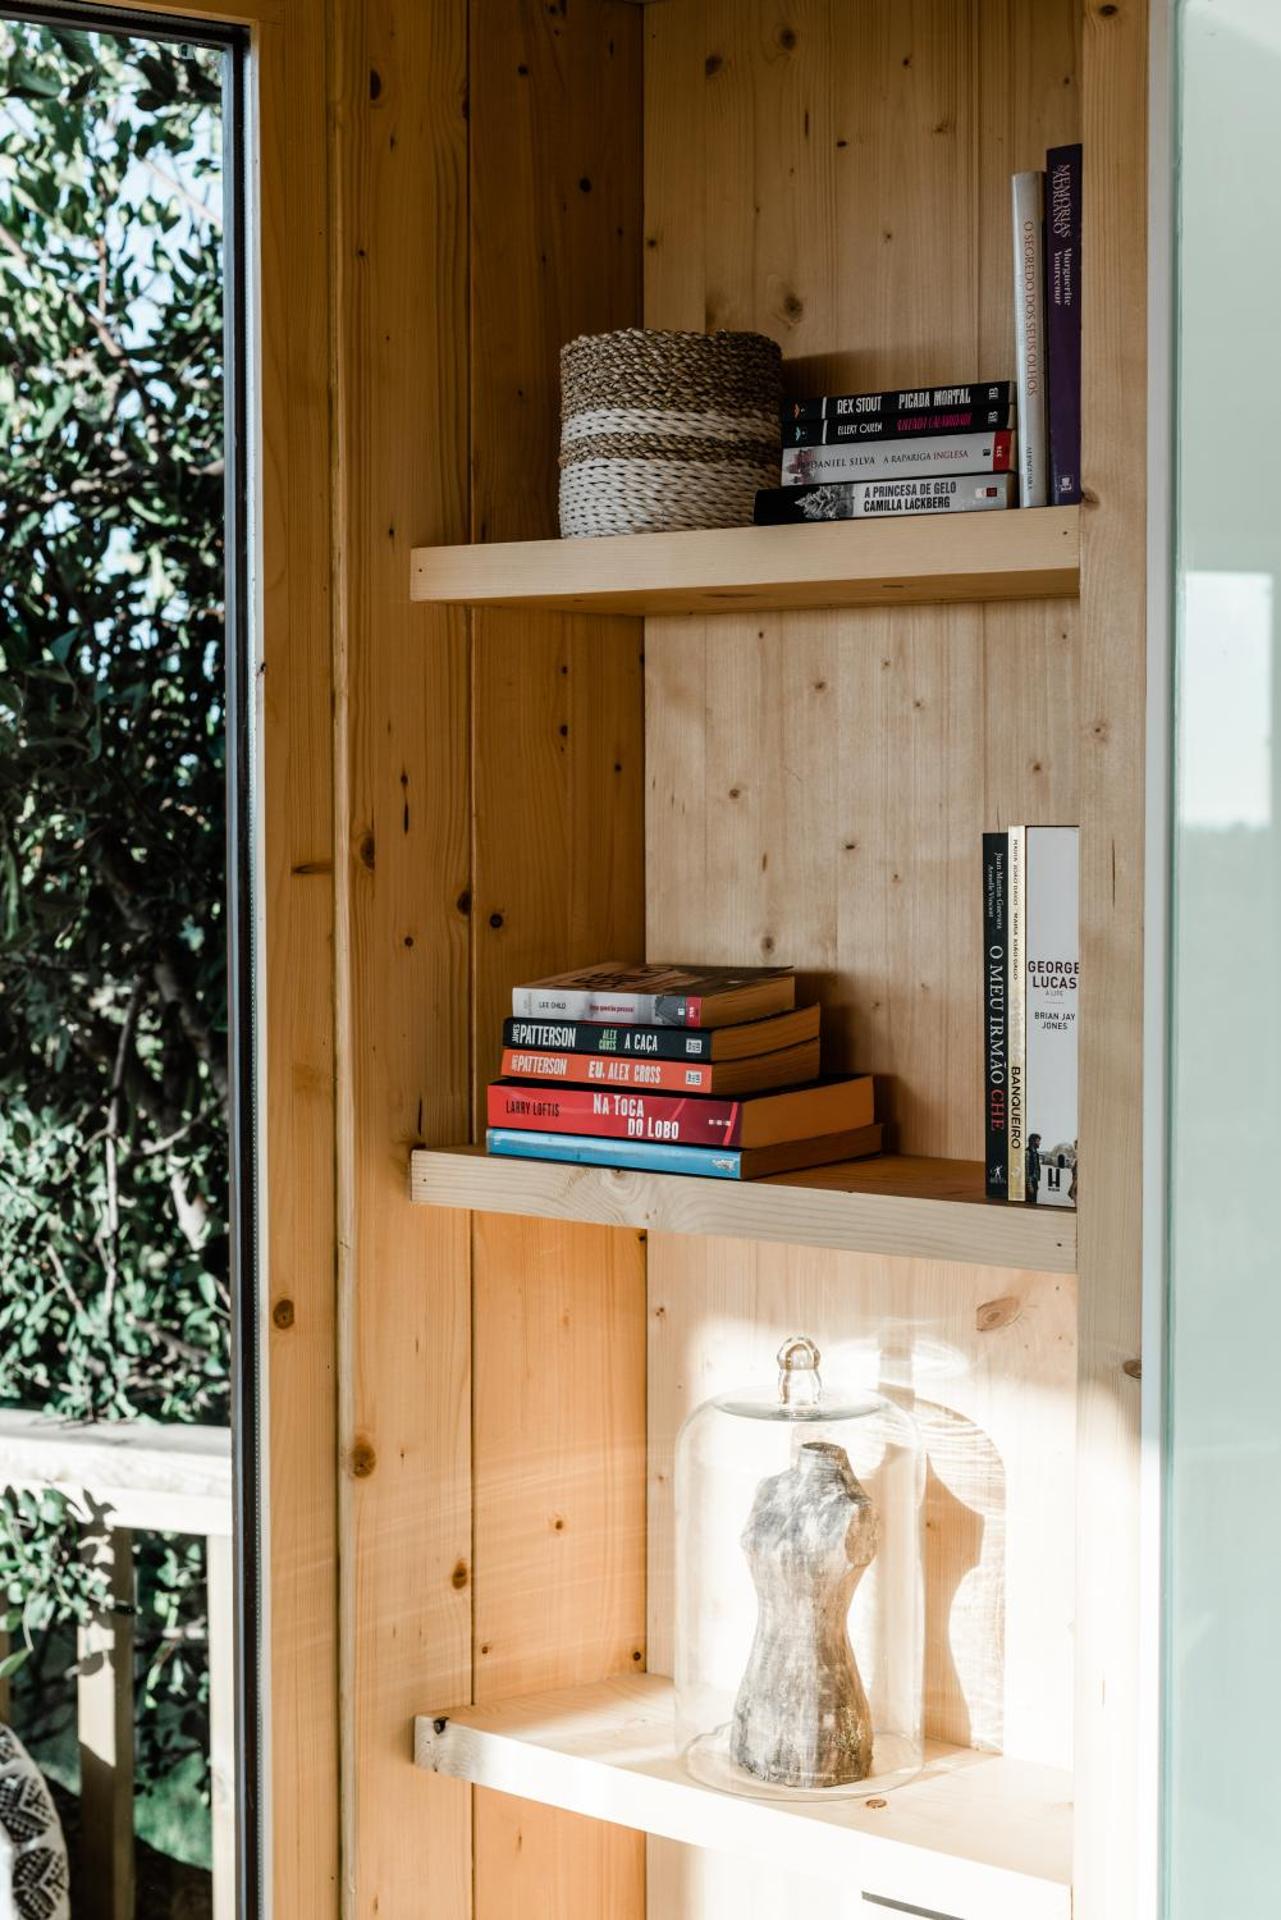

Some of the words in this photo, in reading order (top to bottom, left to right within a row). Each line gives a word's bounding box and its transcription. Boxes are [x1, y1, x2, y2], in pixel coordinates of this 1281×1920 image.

[1052, 171, 1062, 234] ADRIANO
[1024, 232, 1034, 291] SEGREDO
[1054, 251, 1062, 305] Yourcenar
[1063, 248, 1072, 306] Marguerite
[1025, 294, 1035, 319] DOS
[1026, 322, 1036, 353] SEUS
[1027, 354, 1037, 396] OLHOS
[837, 398, 854, 414] REX
[855, 396, 882, 413] STOUT
[898, 392, 930, 409] PICADA
[933, 388, 971, 406] MORTAL
[837, 424, 858, 436] ELLERY
[859, 422, 883, 433] QUEEN
[811, 458, 847, 469] DANIEL
[848, 456, 875, 466] SILVA
[892, 453, 931, 463] RAPARIGA
[933, 450, 968, 460] INGLESA
[864, 487, 870, 498] A
[872, 484, 917, 499] PRINCESA
[920, 483, 931, 495] DE
[934, 481, 957, 494] GELO
[863, 499, 902, 512] CAMILLA
[994, 852, 1003, 870] Juan
[996, 899, 1004, 930] Guevara
[989, 945, 1003, 960] O
[1028, 961, 1079, 974] GEORGE
[990, 965, 1005, 1012] MEU
[1032, 976, 1077, 989] LUCAS
[1034, 1012, 1059, 1020] BRIAN
[1062, 1012, 1076, 1021] JAY
[1042, 1022, 1068, 1030] JONES
[520, 1024, 576, 1047] PATTERSON
[602, 1029, 618, 1040] ALEX
[624, 1033, 631, 1049] A
[634, 1034, 658, 1053] CAÇA
[598, 1039, 617, 1051] CROSS
[990, 1016, 1007, 1084] IRMÃO
[519, 1055, 568, 1076] PATTERSON
[607, 1062, 631, 1081] ALEX
[634, 1064, 661, 1084] CROSS
[506, 1100, 530, 1115] LARRY
[533, 1101, 560, 1117] LOFTIS
[991, 1089, 1005, 1132] CHE
[1010, 1066, 1021, 1149] BANQUEIRO
[628, 1118, 643, 1136] DO
